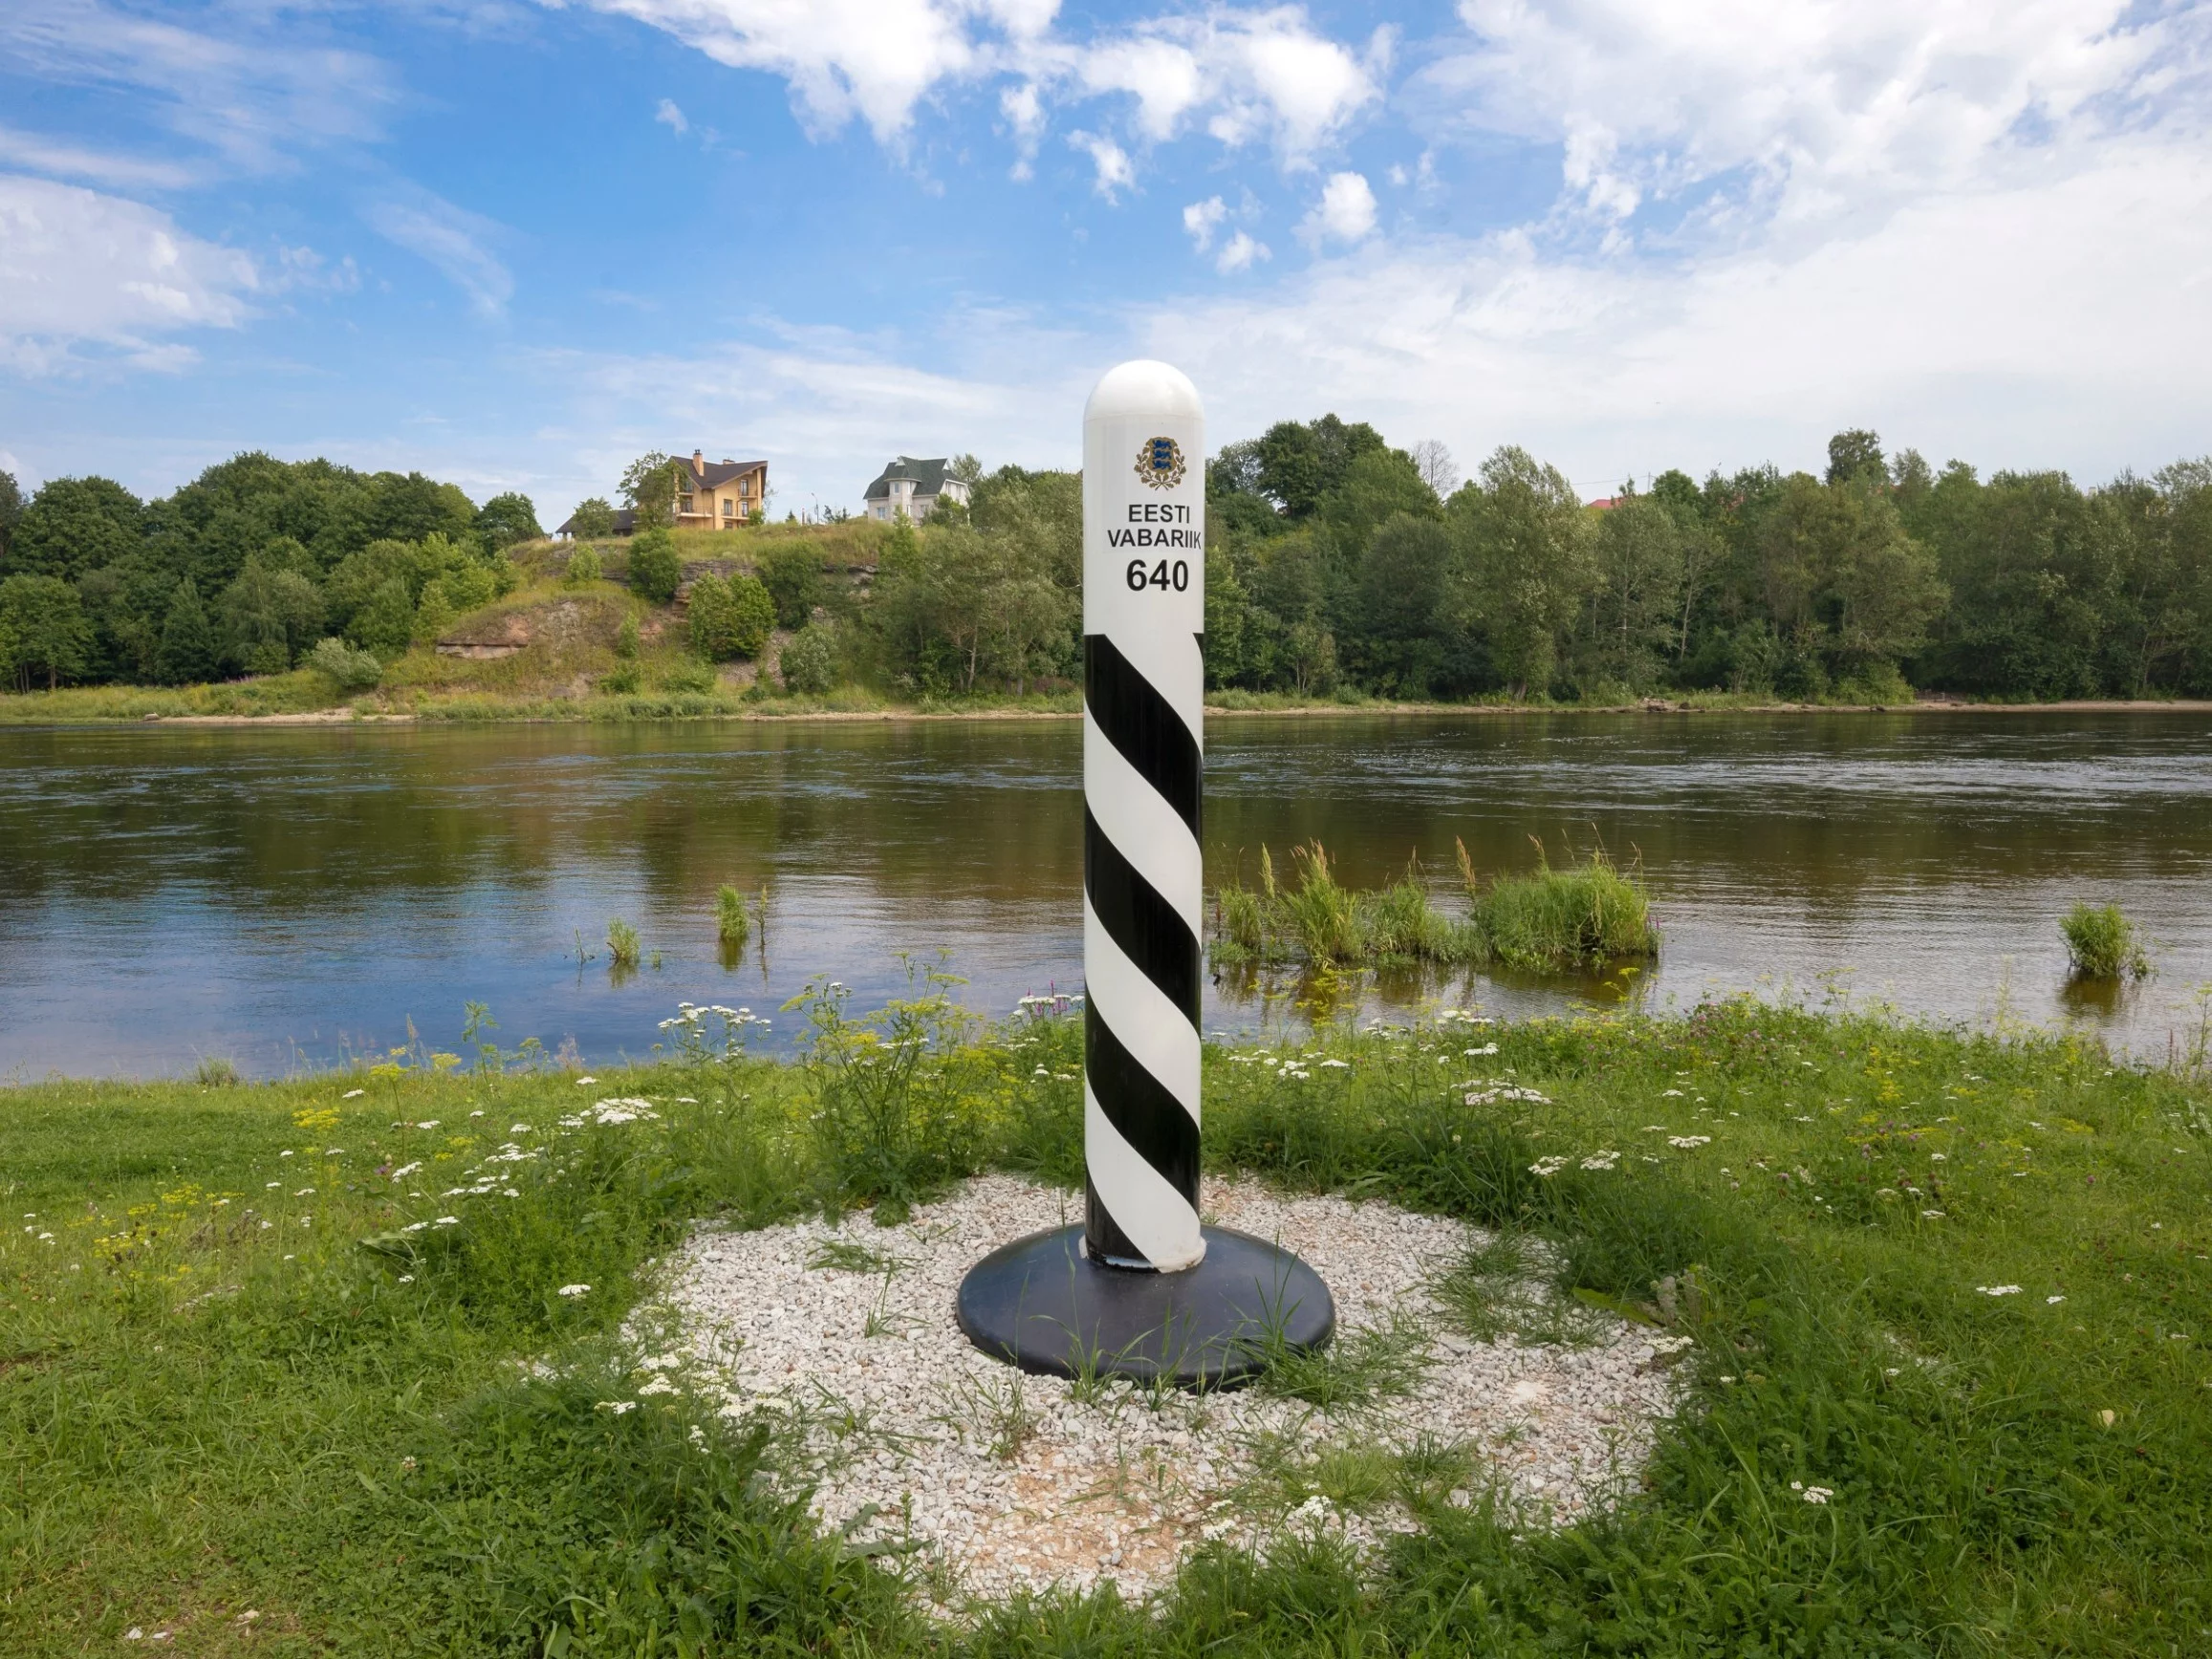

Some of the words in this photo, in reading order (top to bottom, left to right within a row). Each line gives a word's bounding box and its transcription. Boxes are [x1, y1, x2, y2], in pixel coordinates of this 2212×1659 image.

[1128, 504, 1190, 524] EESTI
[1107, 528, 1202, 549] VABARIIK
[1126, 559, 1189, 592] 640
